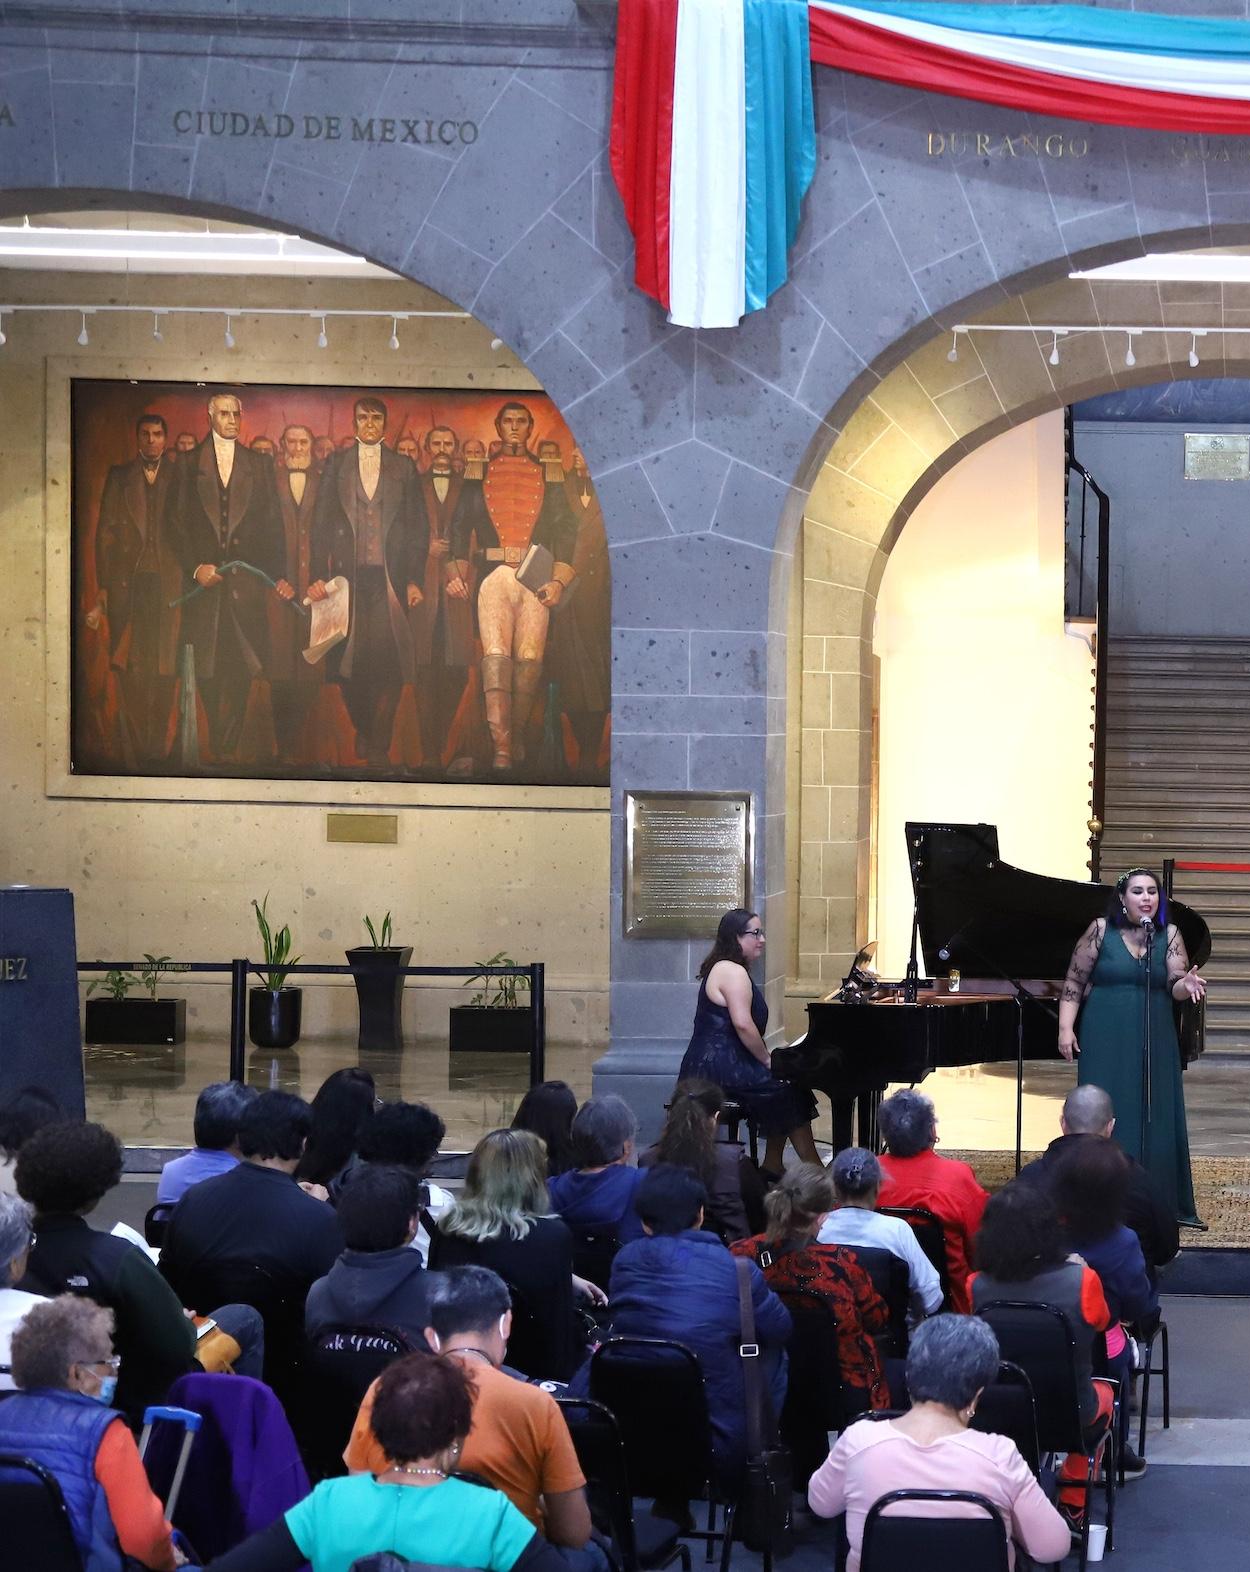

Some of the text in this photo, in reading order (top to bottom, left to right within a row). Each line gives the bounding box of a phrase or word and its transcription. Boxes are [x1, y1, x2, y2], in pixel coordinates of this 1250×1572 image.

[172, 110, 478, 145] CIUDAD DE MEXICO
[927, 133, 1088, 158] DURANGO
